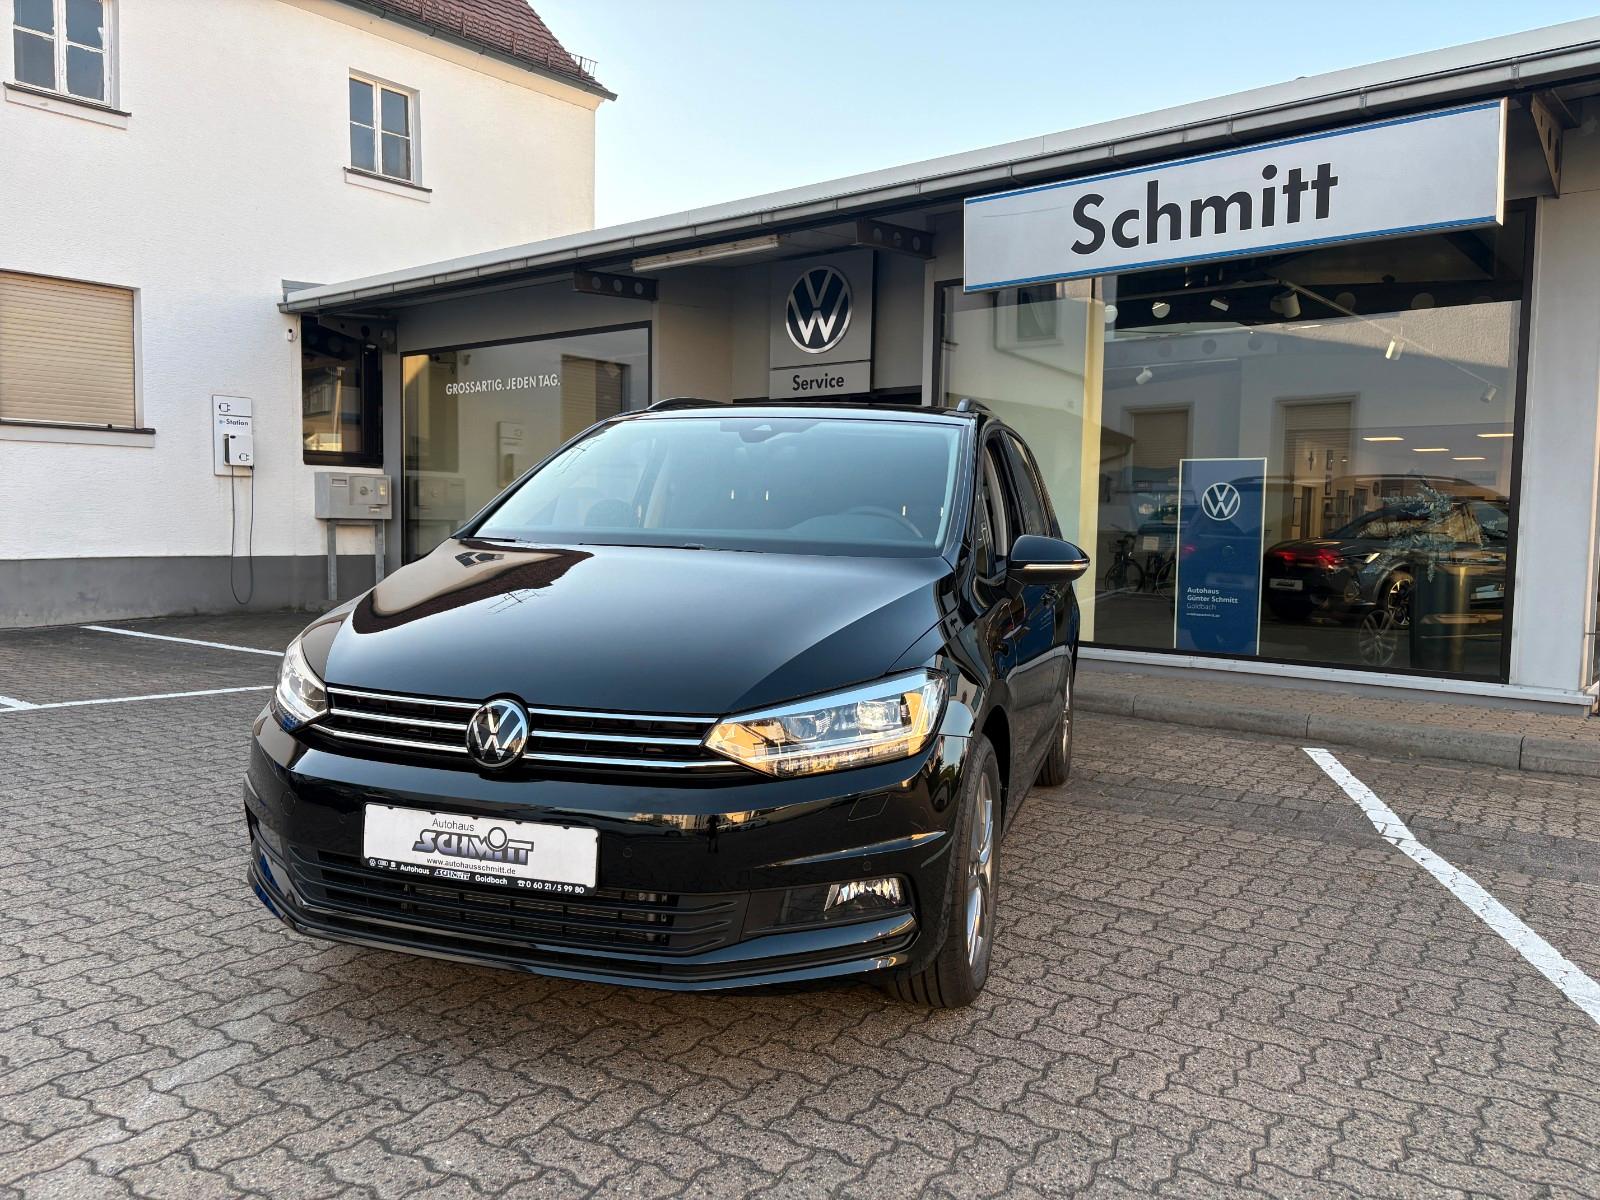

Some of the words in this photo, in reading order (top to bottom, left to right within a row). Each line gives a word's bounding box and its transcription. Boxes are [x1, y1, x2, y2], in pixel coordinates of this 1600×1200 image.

[1071, 162, 1339, 255] Schmitt
[445, 379, 505, 395] GROSSARTIG.
[506, 376, 537, 390] JEDEN
[538, 374, 561, 387] TAG.
[792, 373, 844, 391] Service
[1187, 587, 1220, 595] Autohaus
[1187, 594, 1210, 602] Günter
[1211, 596, 1239, 604] Schmitt
[1186, 602, 1217, 610] Goldbach
[432, 817, 475, 832] Autohaus
[426, 857, 516, 875] www.autohausschmitt.de
[400, 864, 430, 875] Autohaus
[475, 874, 508, 886] Goldbach
[574, 886, 585, 894] 80
